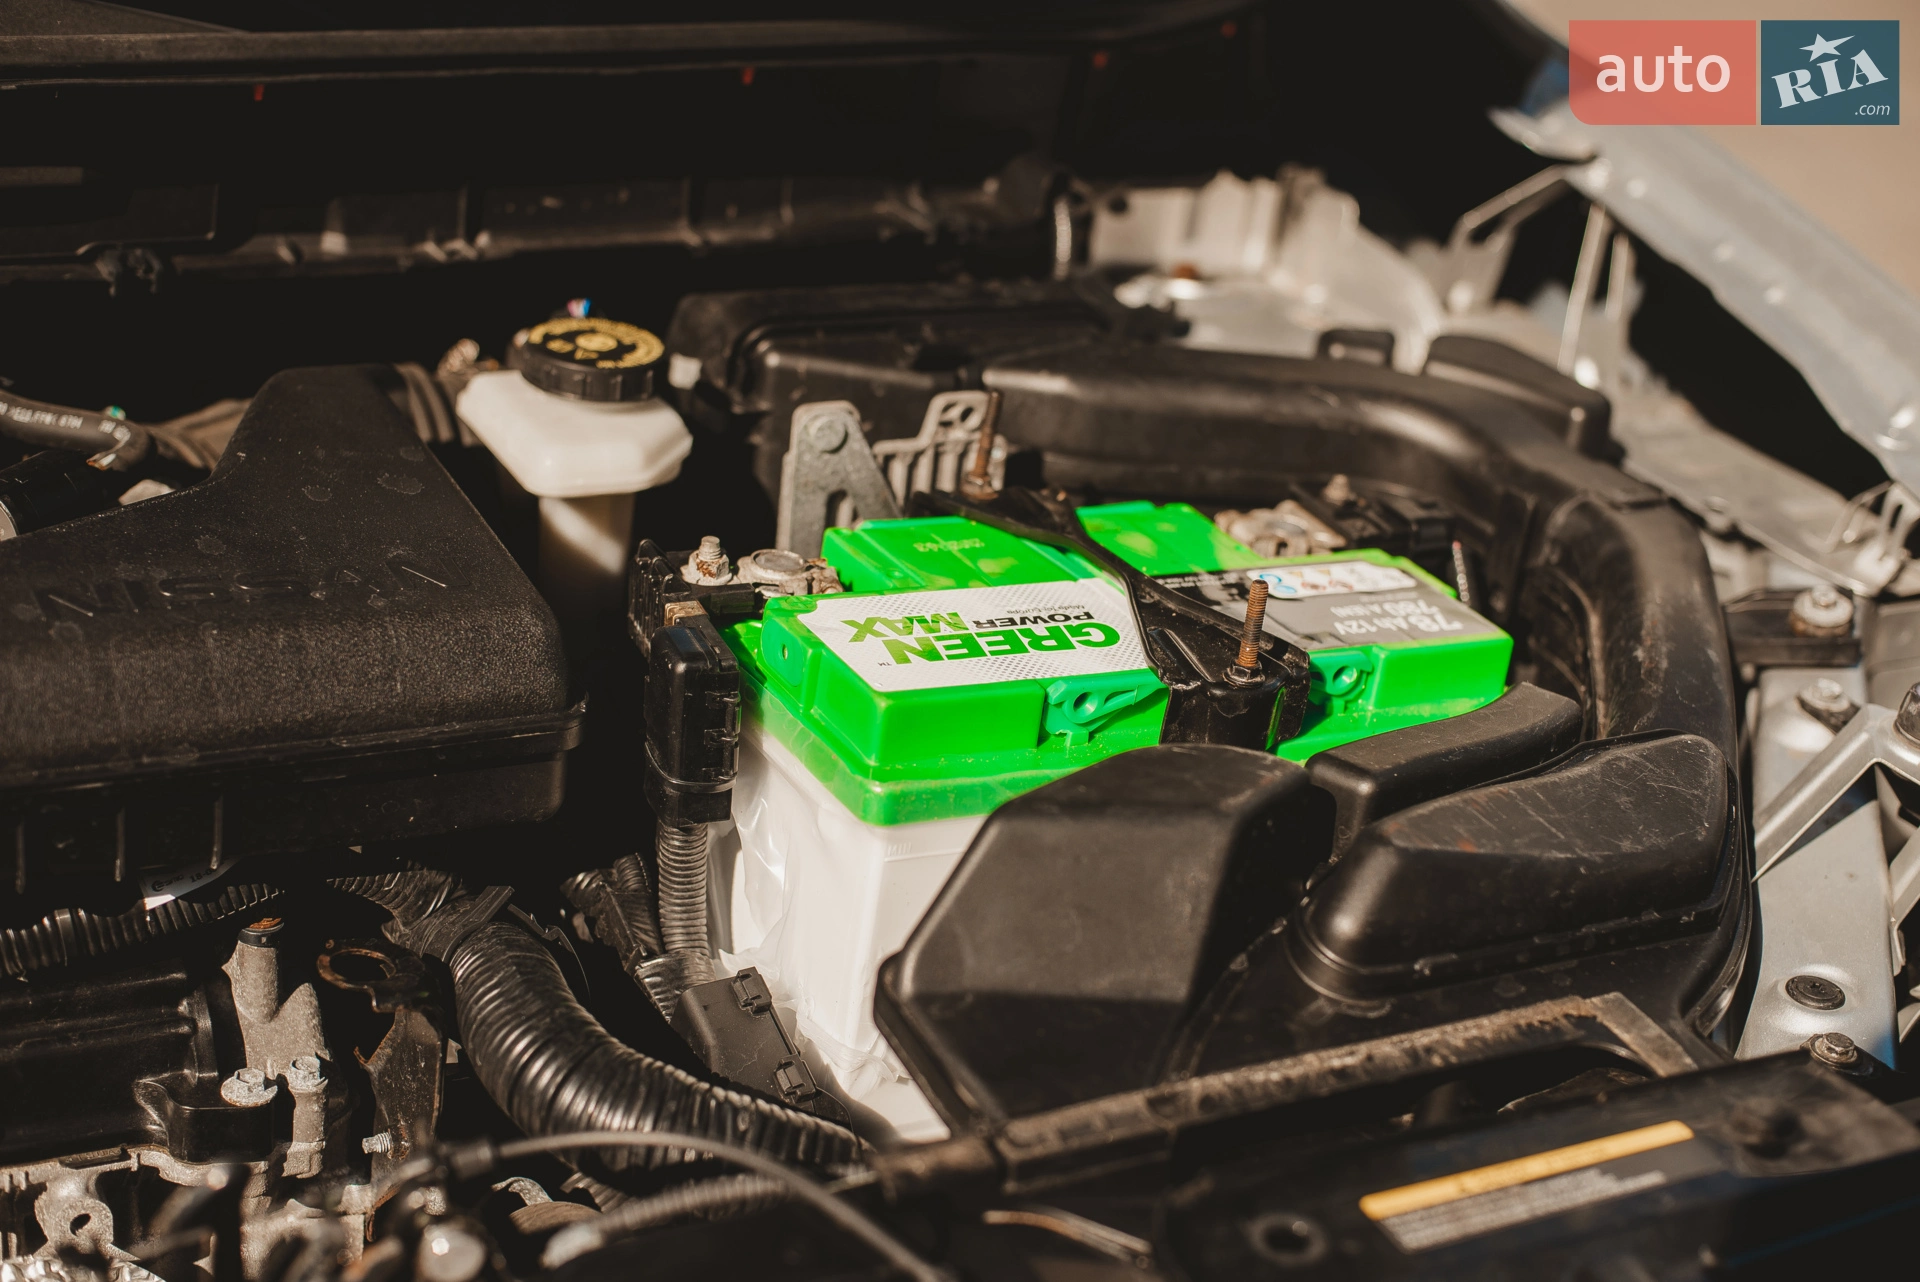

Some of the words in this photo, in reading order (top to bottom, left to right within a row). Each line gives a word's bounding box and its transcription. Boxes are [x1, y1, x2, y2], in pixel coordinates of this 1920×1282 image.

[30, 555, 471, 622] NISSAN
[840, 612, 970, 643] MAX
[972, 611, 1095, 629] POWER
[882, 622, 1120, 665] GREEN
